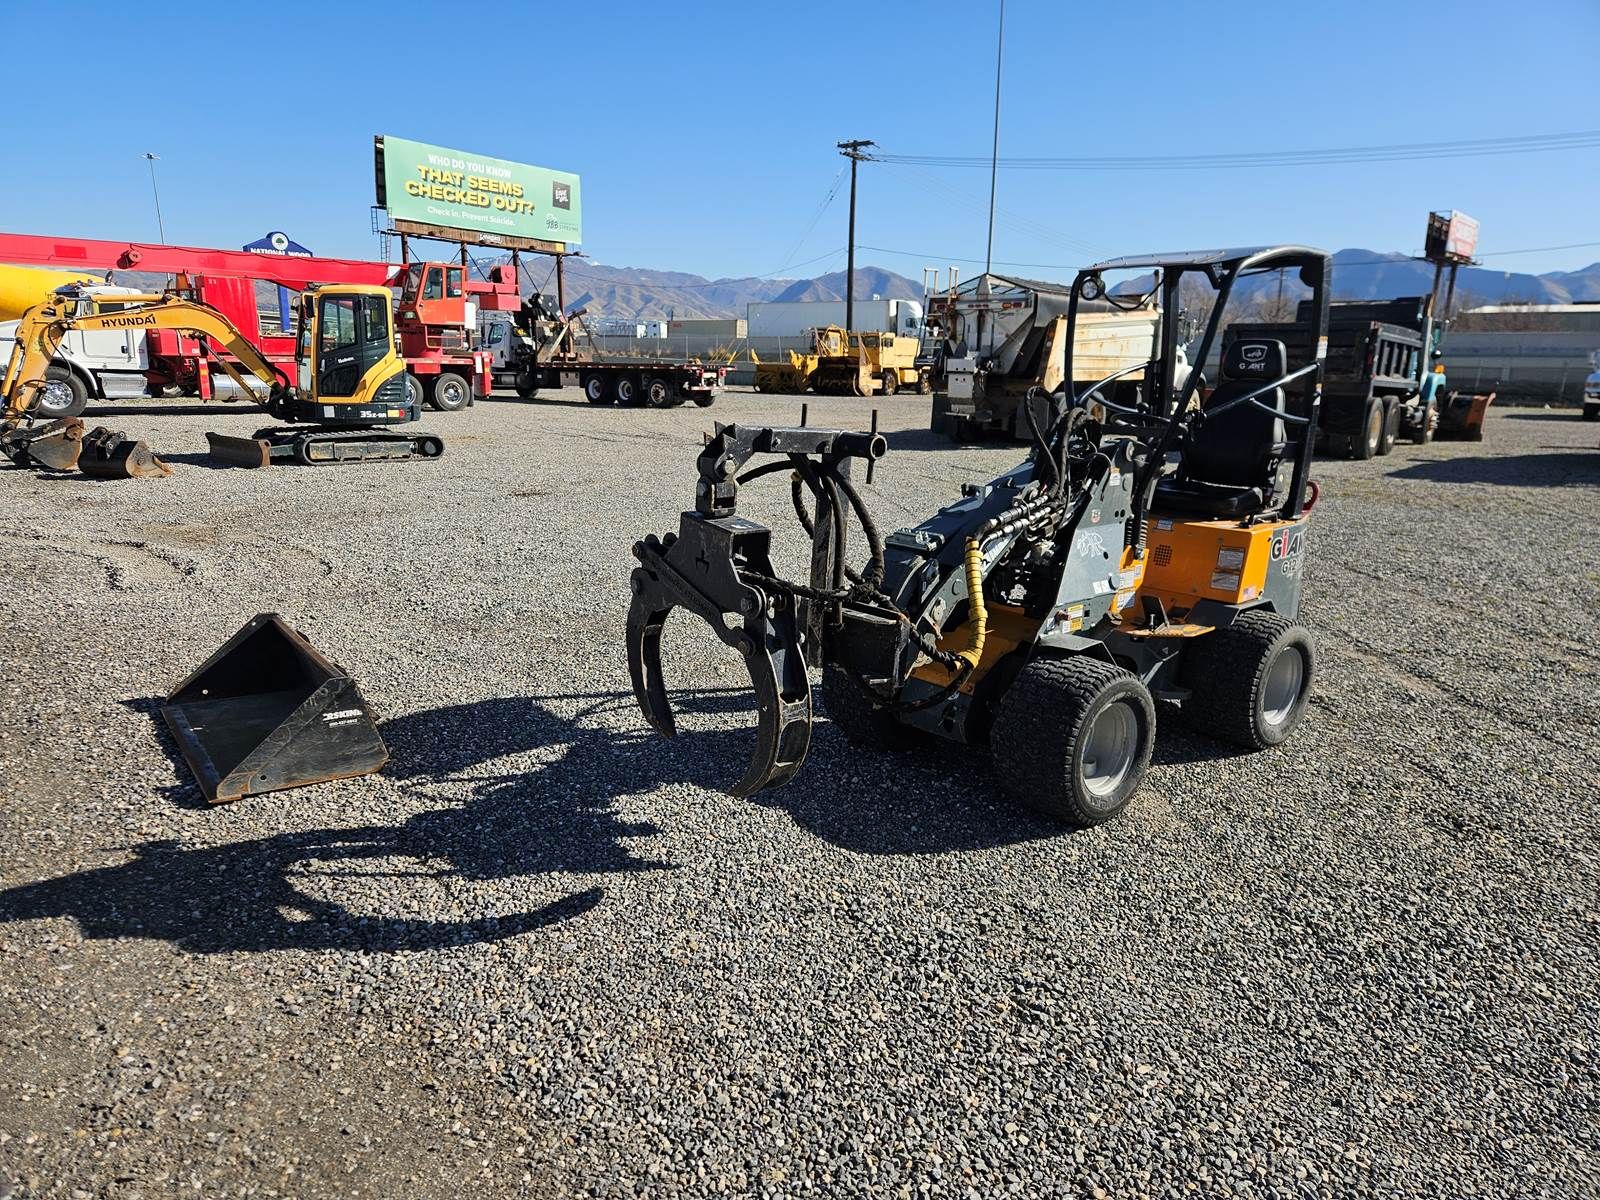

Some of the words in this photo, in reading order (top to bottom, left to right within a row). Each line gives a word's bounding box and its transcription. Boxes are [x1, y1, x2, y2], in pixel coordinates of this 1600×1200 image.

[427, 154, 450, 167] WHO
[452, 159, 464, 170] DO
[467, 162, 485, 173] YOU
[485, 165, 512, 179] KNOW
[417, 164, 465, 188] THAT
[467, 175, 524, 199] SEEMS
[405, 180, 491, 208] CHECKED
[492, 195, 535, 215] OUT?
[427, 206, 451, 217] Check
[462, 211, 488, 223] Prevent
[250, 248, 285, 256] NATIONAL
[102, 314, 156, 327] HYUNDAI
